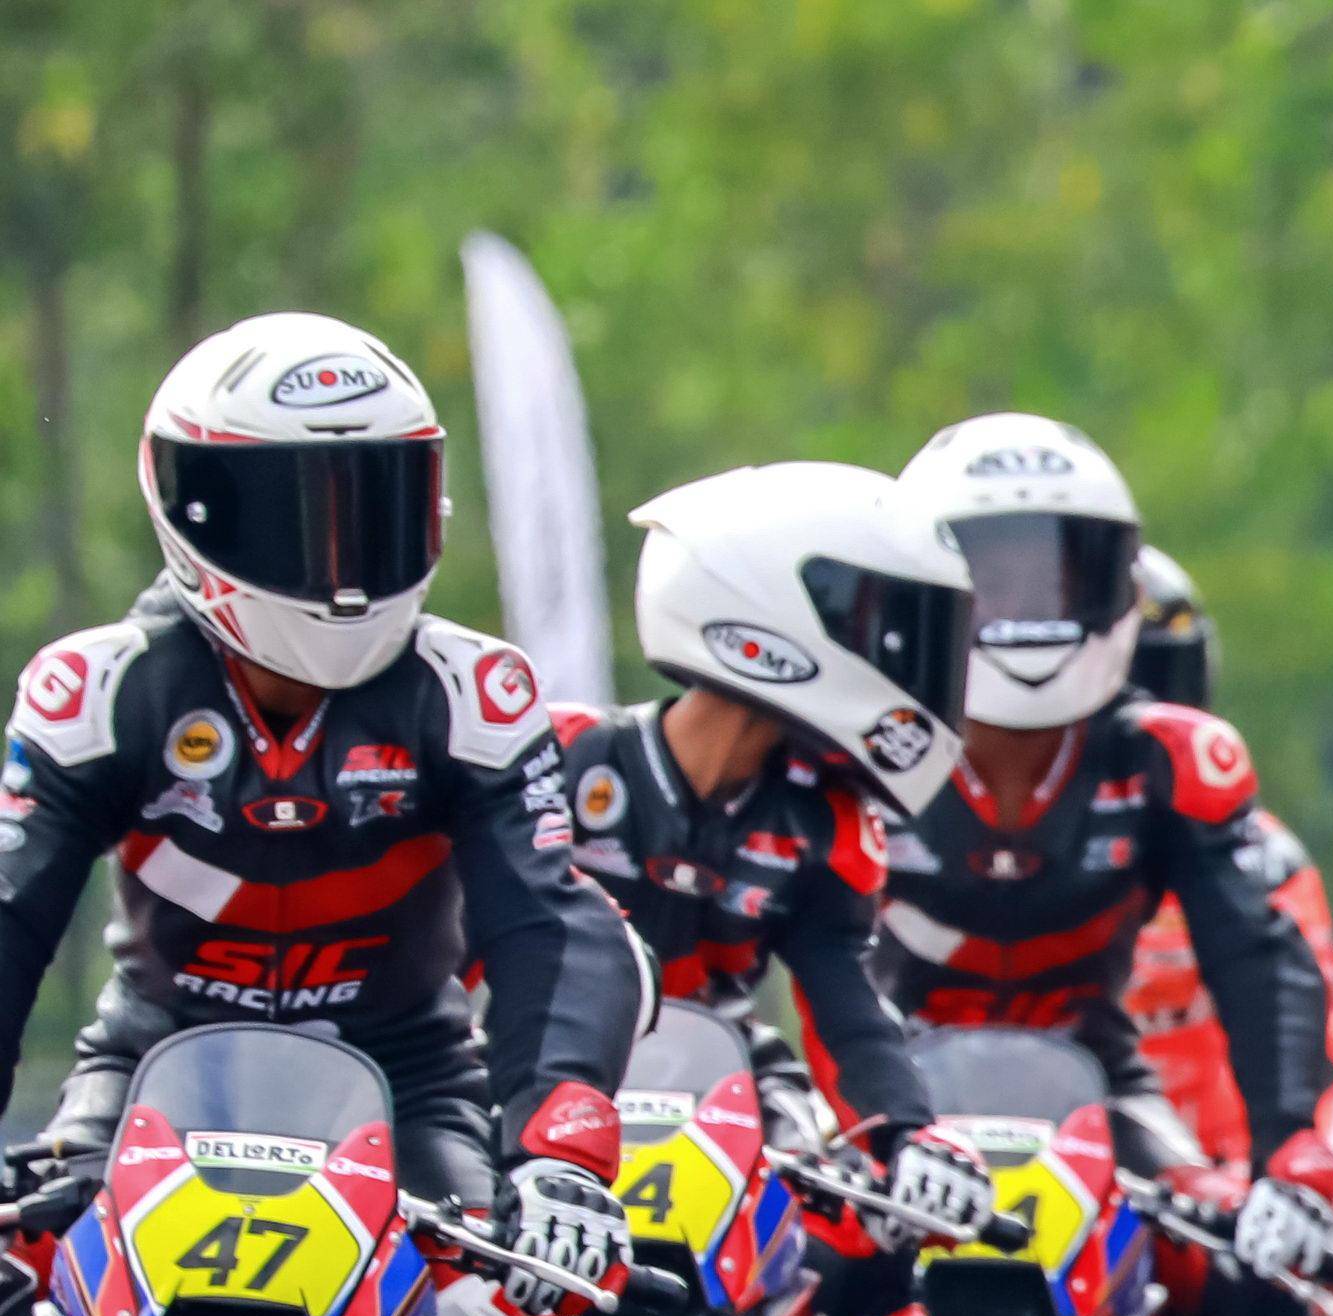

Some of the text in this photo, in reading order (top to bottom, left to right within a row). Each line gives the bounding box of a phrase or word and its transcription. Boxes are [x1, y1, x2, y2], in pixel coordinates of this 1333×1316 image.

[182, 934, 392, 991] SIC
[172, 972, 363, 1012] RACING
[197, 1140, 314, 1165] DELLORTO
[174, 1216, 310, 1291] 47
